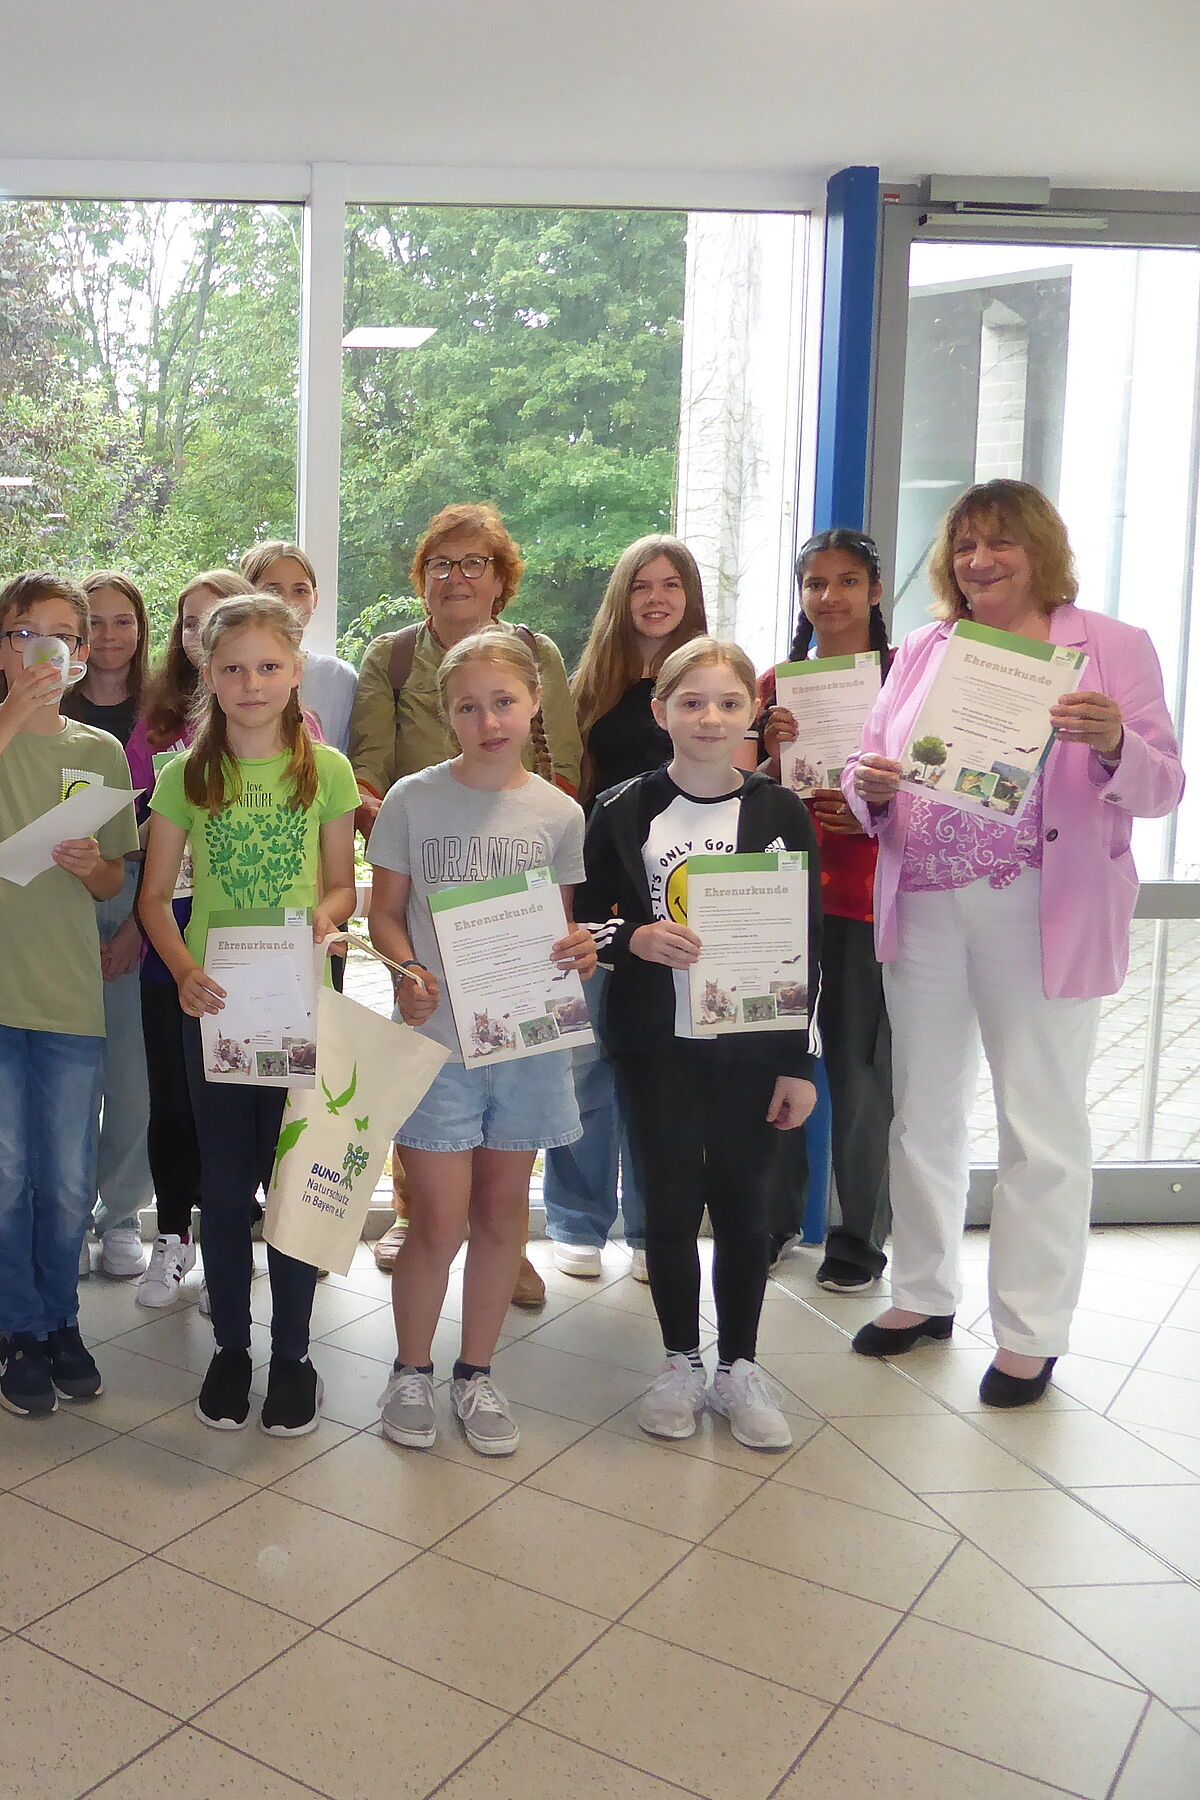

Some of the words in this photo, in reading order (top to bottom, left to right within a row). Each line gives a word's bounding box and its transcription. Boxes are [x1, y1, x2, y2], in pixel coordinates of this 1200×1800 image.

[963, 653, 1052, 687] Ehrenurkunde
[246, 781, 263, 791] love
[237, 792, 273, 808] NATURE
[421, 836, 546, 884] ORANGE
[660, 841, 693, 868] ONLY
[704, 838, 734, 853] GOO
[704, 885, 789, 898] Ehrenurkunde
[453, 903, 544, 932] Ehrenurkunde
[218, 940, 295, 951] Ehrenurkunde
[311, 1162, 340, 1183] BUND
[302, 1191, 311, 1203] in
[312, 1195, 335, 1213] Bayern
[306, 1178, 350, 1206] Naturschutz
